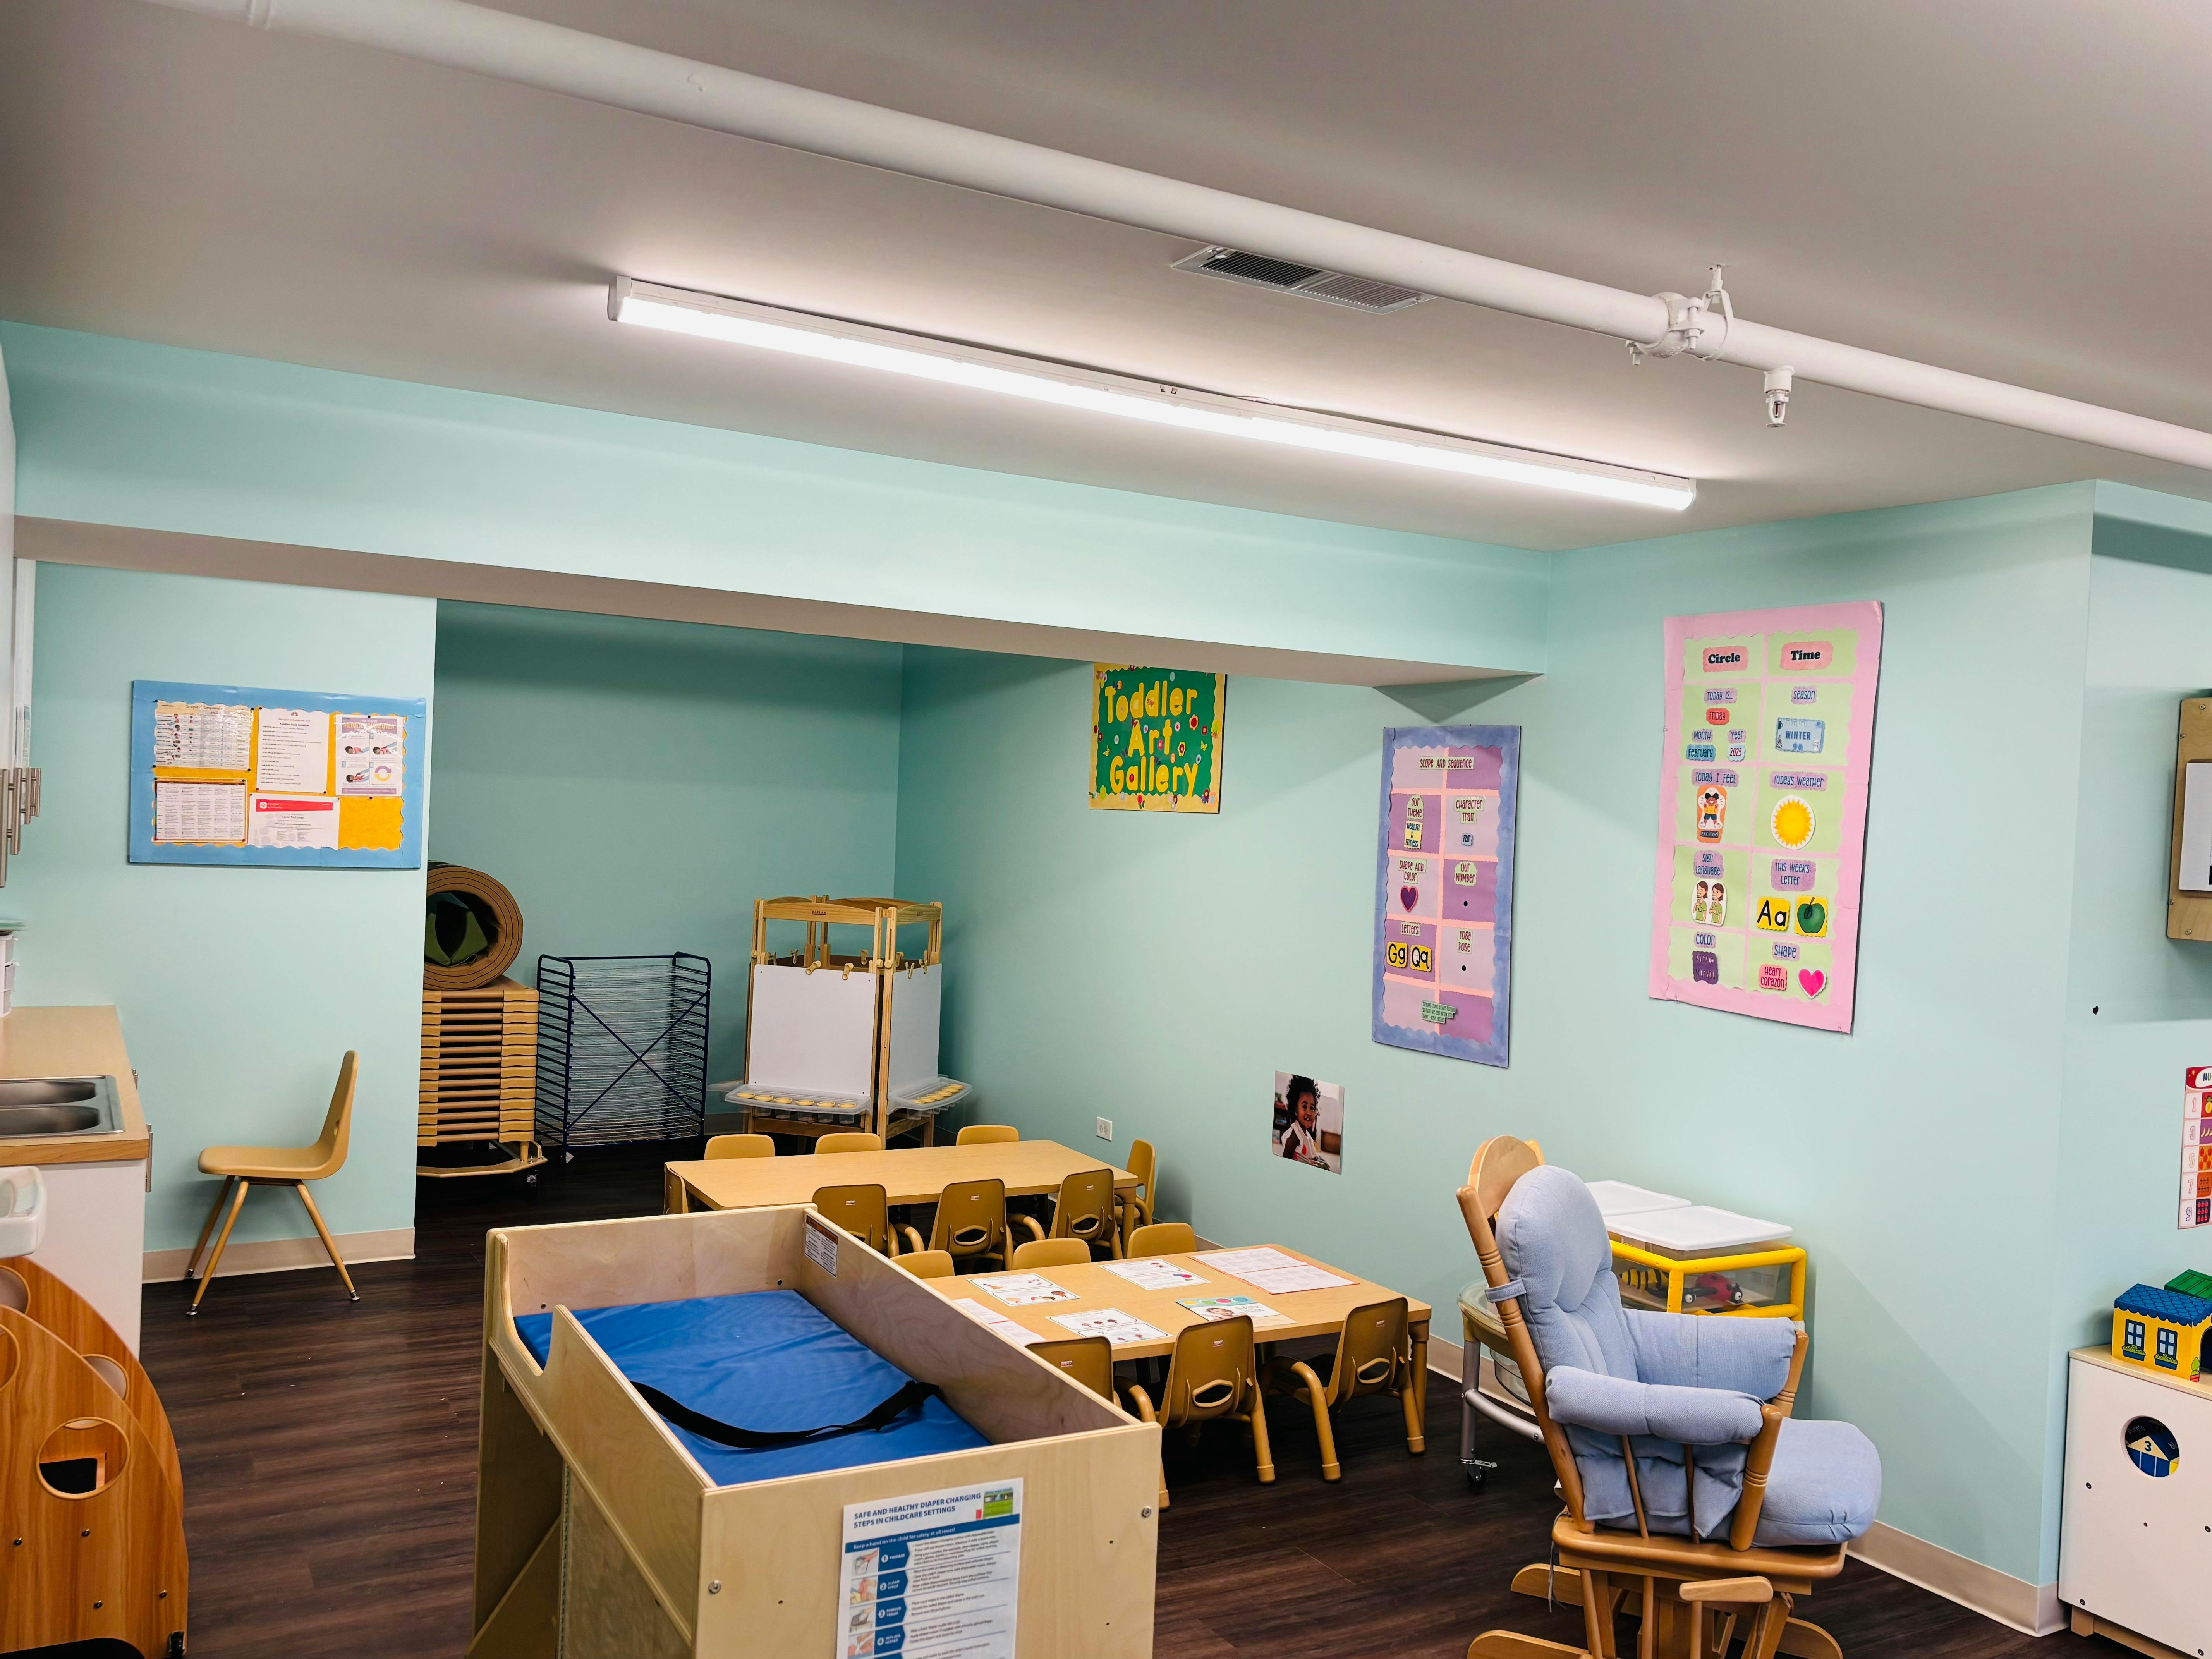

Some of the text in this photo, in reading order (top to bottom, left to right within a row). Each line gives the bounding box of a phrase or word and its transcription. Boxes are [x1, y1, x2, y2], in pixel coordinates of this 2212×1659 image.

[1708, 653, 1740, 664] Circle
[1791, 651, 1820, 661] Time
[1105, 680, 1197, 723] Toddler
[1128, 719, 1172, 757] Art
[1786, 730, 1811, 740] WINTER
[1730, 748, 1742, 756] 2025
[1110, 756, 1198, 797] Gallery
[1716, 773, 1719, 783] I
[1757, 900, 1786, 926] Aa
[1388, 943, 1405, 964] Gg
[1411, 946, 1430, 969] Qq
[2192, 1097, 2197, 1113] 1
[2190, 1125, 2196, 1140] 3
[2189, 1152, 2195, 1168] 5
[2188, 1179, 2194, 1194] 7
[2186, 1206, 2192, 1222] 9
[2144, 1441, 2152, 1451] 3
[854, 1493, 981, 1519] SAFE AND HEALTHY DIAPER CHANGING
[854, 1520, 875, 1528] STEPS
[884, 1511, 922, 1523] CHILDCARE
[924, 1506, 955, 1516] SETTINGS
